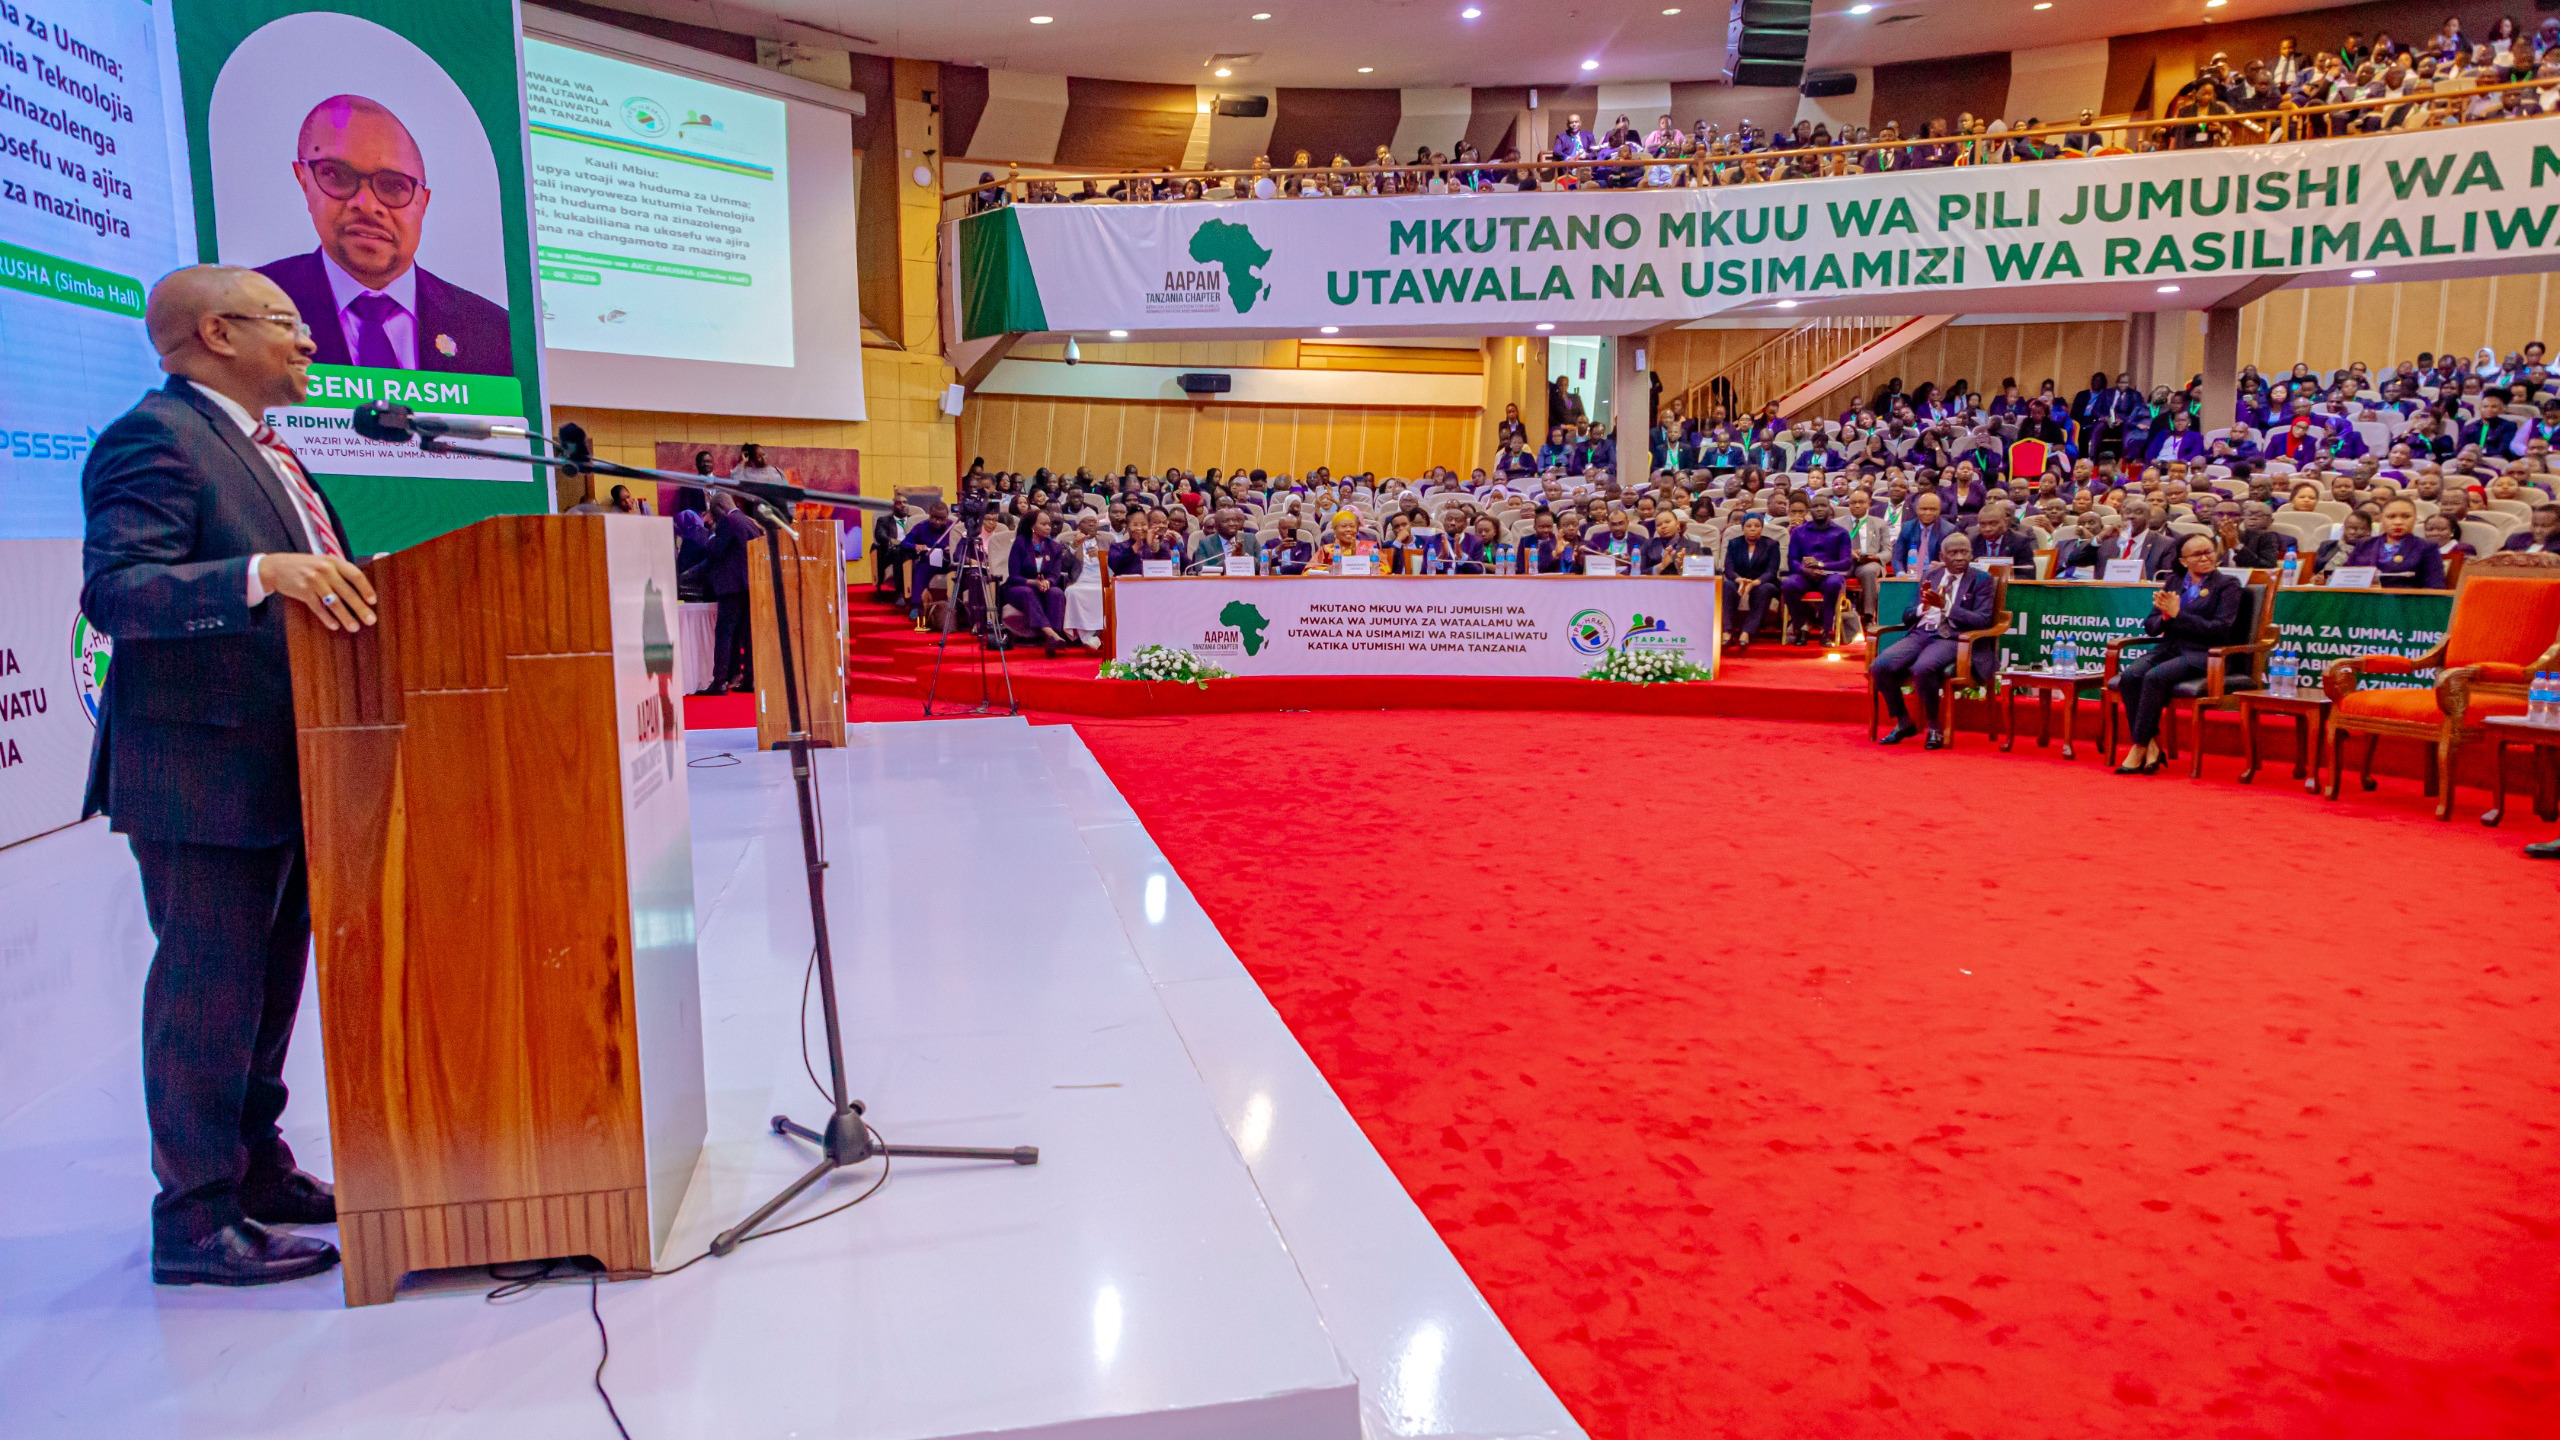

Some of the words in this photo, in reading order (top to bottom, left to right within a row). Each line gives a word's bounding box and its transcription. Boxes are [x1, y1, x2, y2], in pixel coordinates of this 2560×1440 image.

[25, 14, 48, 41] za
[53, 23, 123, 83] Umma;
[32, 54, 133, 123] Teknolojia
[551, 88, 608, 106] UTAWALA
[574, 81, 594, 93] WA
[527, 103, 546, 114] MA
[551, 109, 612, 128] TANZANIA
[57, 156, 86, 183] wa
[92, 168, 133, 200] ajira
[585, 157, 618, 170] Kauli
[622, 163, 659, 178] Mbiu:
[536, 165, 571, 177] upya
[575, 171, 613, 185] utoaji
[618, 179, 636, 188] wa
[640, 181, 690, 198] huduma
[694, 192, 707, 201] za
[3, 179, 27, 205] za
[33, 189, 131, 239] mazingira
[560, 181, 637, 204] inavyoweza
[641, 195, 692, 212] kutumia
[697, 205, 755, 223] Teknolojia
[1389, 213, 1641, 255] MKUTANO
[1658, 203, 1809, 248] MKUU
[1826, 196, 1919, 238] WA
[1937, 188, 2041, 232] PILI
[2058, 164, 2360, 226] JUMUISHI
[2385, 150, 2504, 200] WA
[534, 192, 556, 203] sha
[561, 196, 617, 213] huduma
[620, 206, 650, 219] bora
[654, 213, 669, 222] na
[672, 215, 742, 234] zinazolenga
[553, 210, 631, 230] kukabiliana
[635, 223, 650, 233] na
[654, 226, 702, 241] ukosefu
[705, 234, 722, 243] wa
[725, 236, 750, 248] ajira
[537, 224, 563, 234] ana
[567, 228, 584, 237] na
[587, 230, 668, 249] changamoto
[672, 243, 685, 252] za
[688, 245, 747, 260] mazingira
[1326, 265, 1576, 306] UTAWALA
[1591, 262, 1664, 300] NA
[1681, 245, 1965, 299] USIMAMIZI
[1985, 240, 2085, 282] WA
[2104, 204, 2560, 277] RASILIMALIW
[55, 270, 105, 300] (Simba
[108, 284, 140, 311] Hall)
[1164, 270, 1220, 291] AAPAM
[1146, 292, 1184, 303] TANZANIA
[1185, 291, 1220, 303] CHAPTER
[306, 375, 373, 400] GENI
[383, 380, 469, 405] RASMI
[266, 415, 282, 428] E.
[287, 416, 354, 430] RIDHIW
[303, 436, 341, 446] WAZIRI
[344, 438, 361, 447] WA
[310, 448, 324, 457] YA
[327, 449, 375, 458] UTUMISHI
[378, 450, 394, 458] WA
[397, 450, 426, 459] UMMA
[1310, 604, 1366, 613] MKUTANO
[1369, 604, 1401, 613] MKUU
[1405, 605, 1423, 613] WA
[1426, 605, 1447, 614] PILI
[1450, 606, 1503, 615] JUMUISHI
[1506, 606, 1526, 615] WA
[1300, 616, 1344, 625] MWAKA
[1347, 617, 1366, 626] WA
[1369, 617, 1418, 626] JUMUIYA
[1421, 618, 1437, 626] ZA
[1440, 618, 1513, 627] WATAALAMU
[1516, 619, 1535, 628] WA
[2041, 614, 2110, 628] KUFIKIRIA
[2115, 617, 2145, 628] UPY
[1204, 630, 1239, 643] AAPAM
[1288, 629, 1344, 638] UTAWALA
[1346, 629, 1363, 638] NA
[1366, 630, 1425, 639] USIMAMIZI
[1428, 630, 1447, 639] WA
[1450, 631, 1548, 641] RASILIMALIWATU
[2279, 623, 2314, 637] UMA
[2320, 625, 2342, 638] ZA
[2348, 627, 2403, 643] UMMA;
[2408, 629, 2442, 644] JINS
[1308, 641, 1348, 650] KATIKA
[1352, 642, 1405, 651] UTUMISHI
[1408, 643, 1427, 651] WA
[1430, 643, 1465, 652] UMMA
[1468, 643, 1527, 653] TANZANIA
